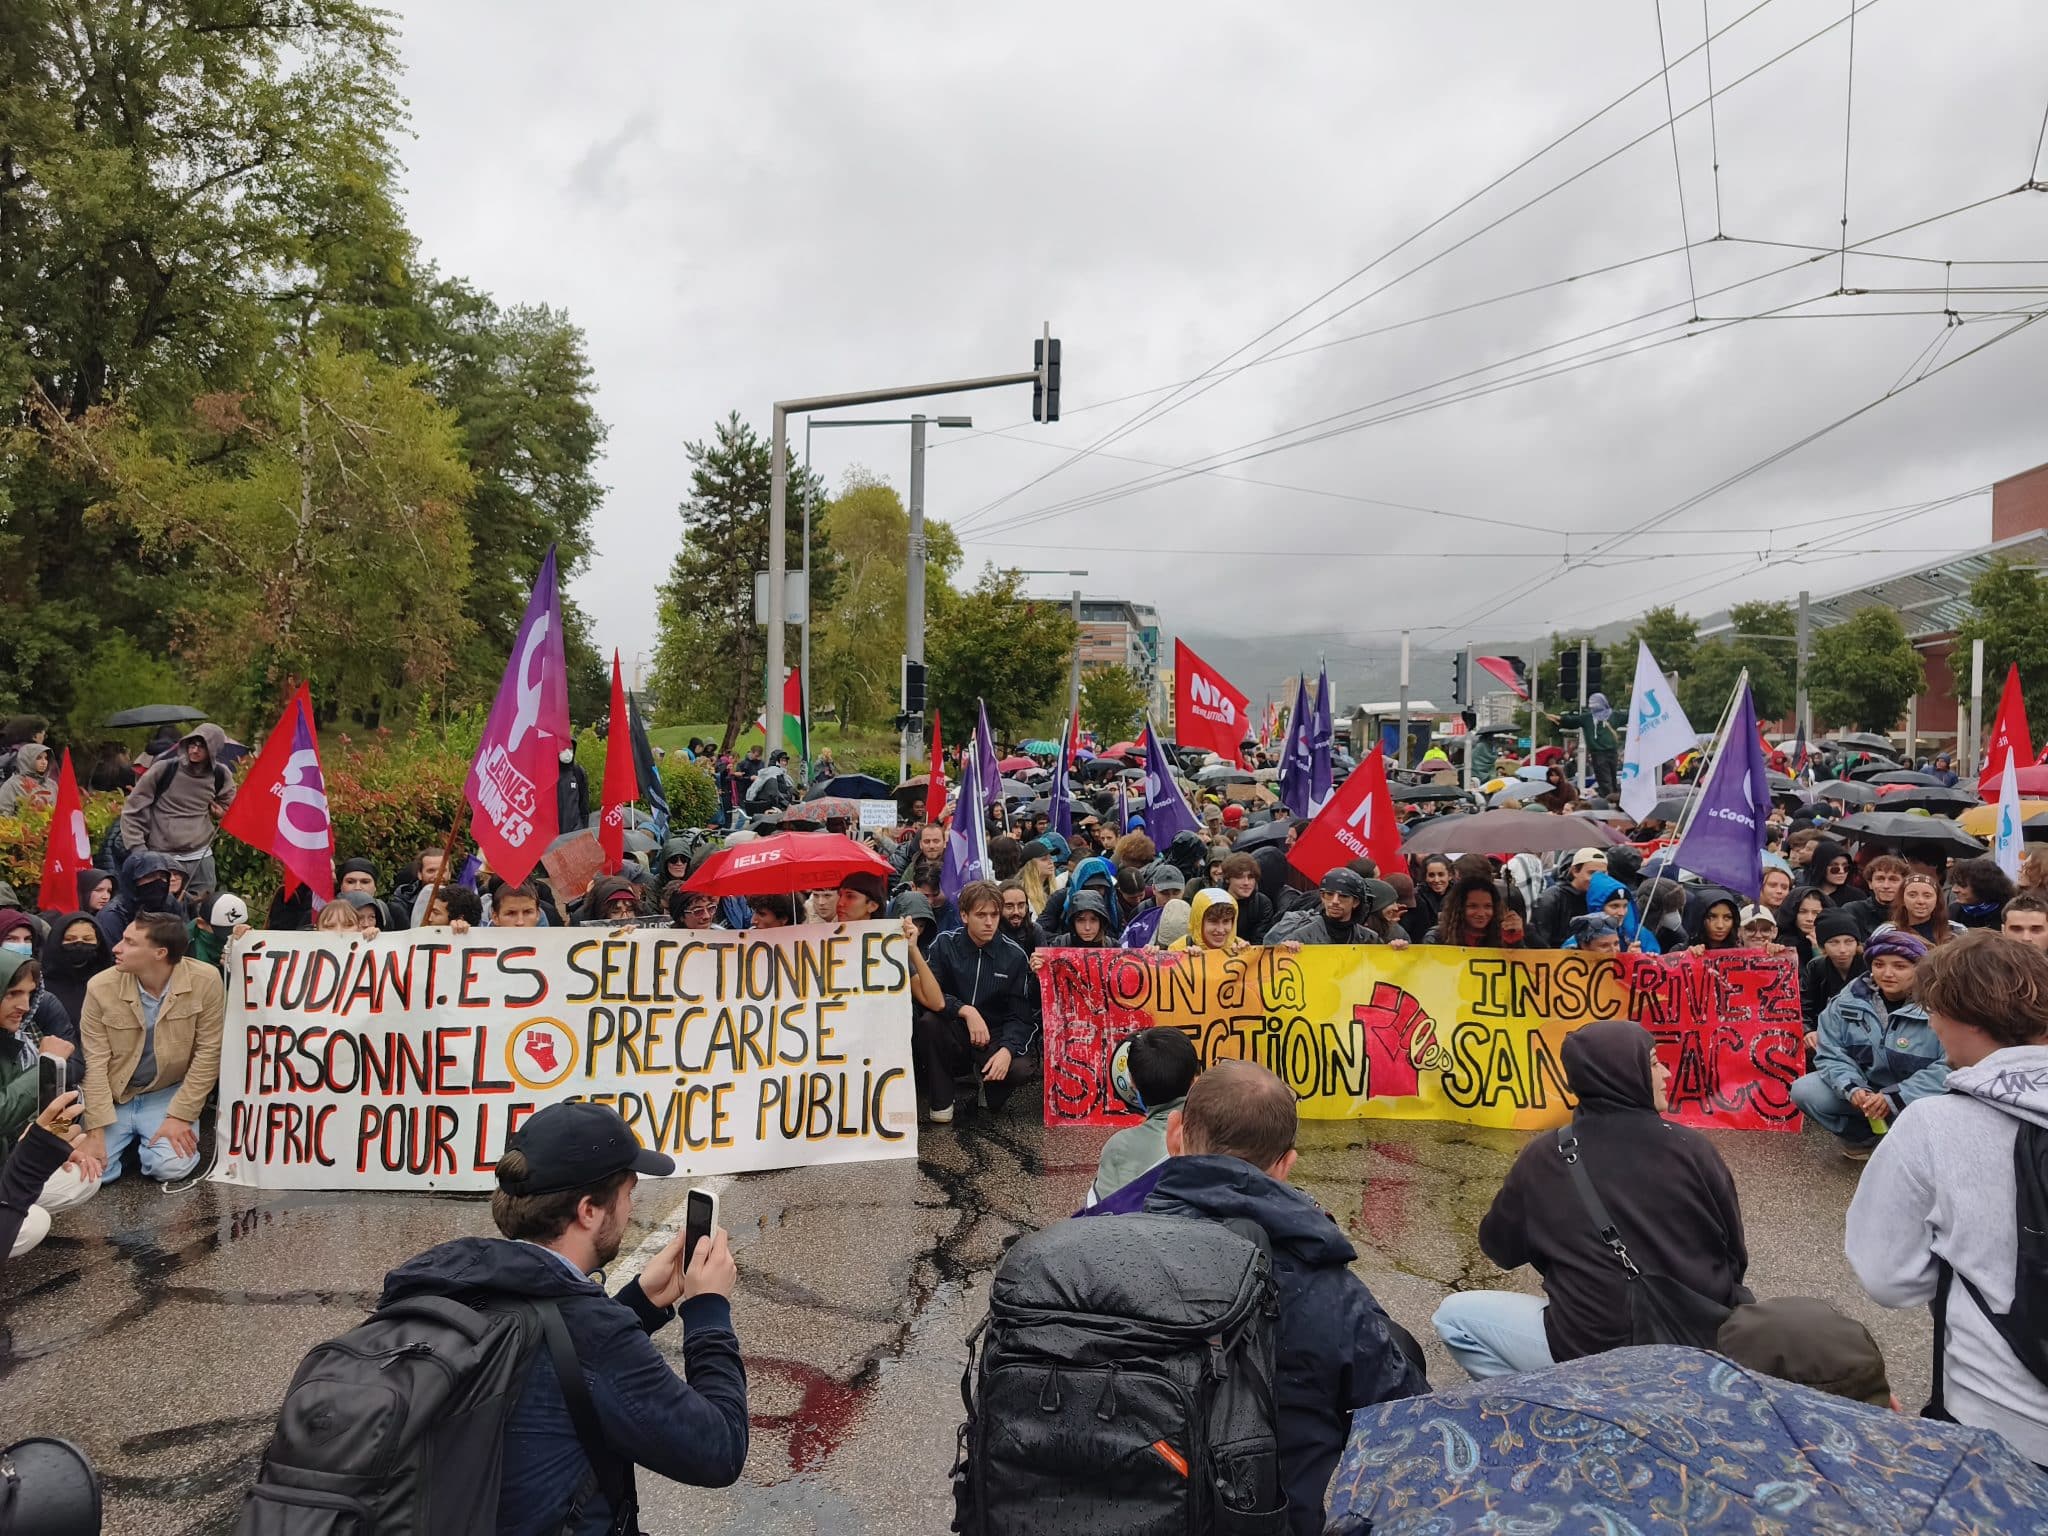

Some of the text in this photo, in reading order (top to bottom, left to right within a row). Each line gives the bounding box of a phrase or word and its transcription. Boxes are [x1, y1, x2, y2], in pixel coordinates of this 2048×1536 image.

[734, 848, 783, 869] IELTS
[1334, 827, 1370, 859] RÉVOLU
[243, 924, 907, 1016] ÉTUDIANT.ES SÉLECTIONNÉ.ES
[1050, 951, 1206, 1016] NON
[1257, 947, 1307, 1013] la
[244, 1025, 515, 1096] PERSONNEL
[1441, 1021, 1580, 1111] SAN
[264, 1102, 337, 1168] FRIC
[356, 1103, 460, 1176] POUR
[561, 1077, 735, 1152] RVICE
[755, 1058, 906, 1142] PUBLIC
